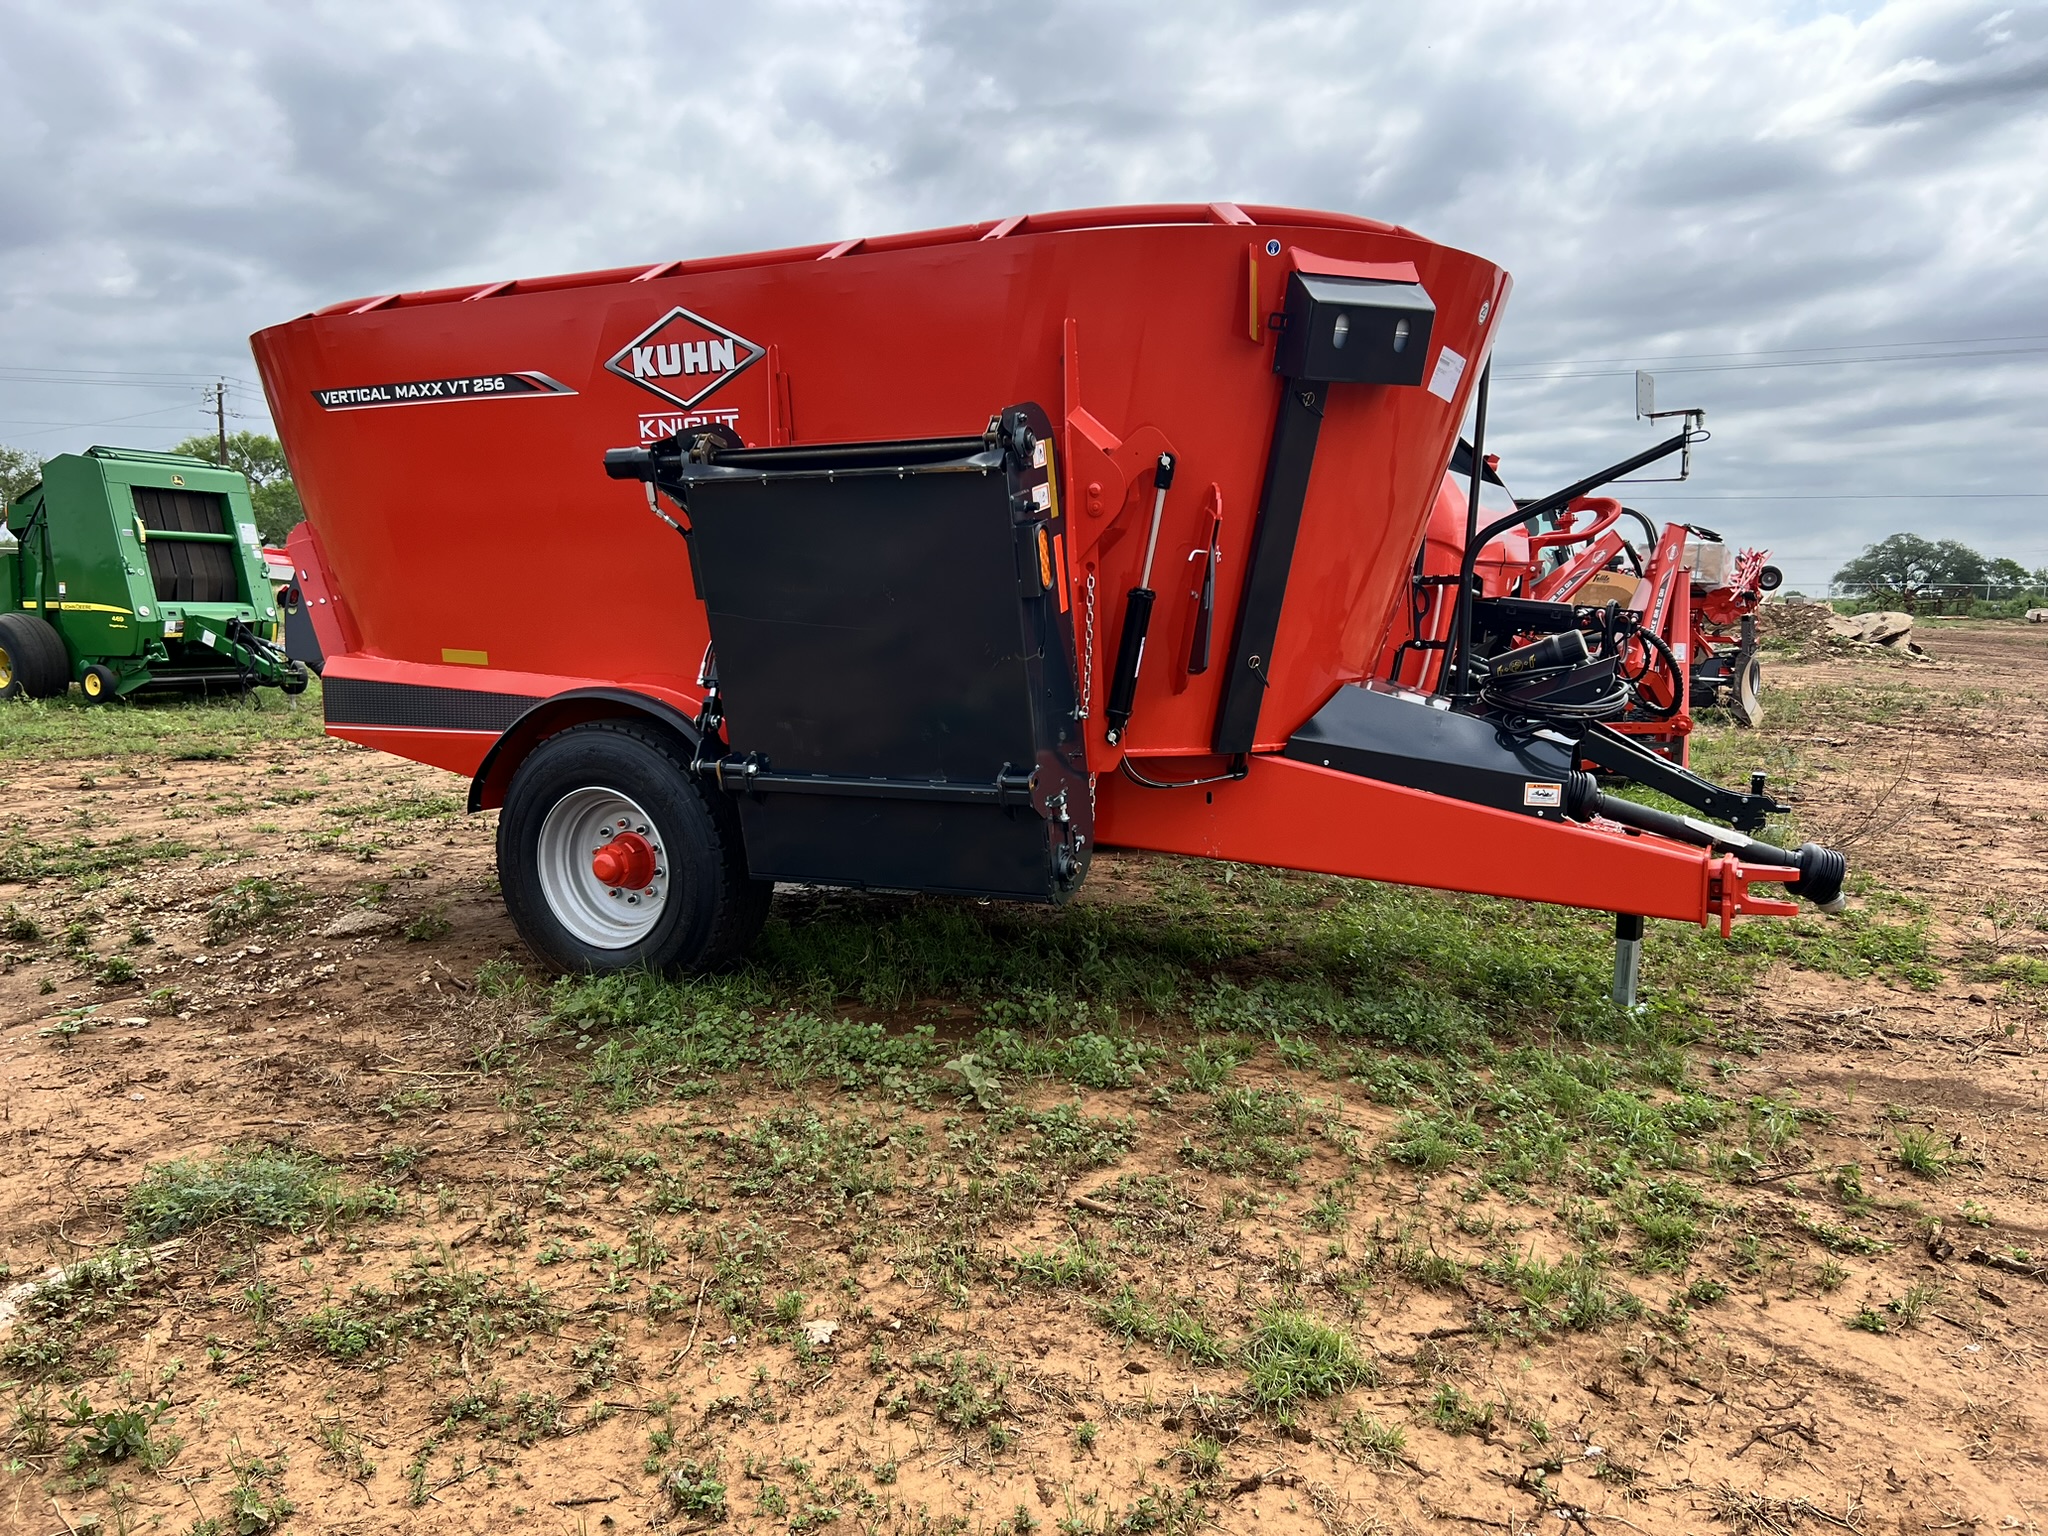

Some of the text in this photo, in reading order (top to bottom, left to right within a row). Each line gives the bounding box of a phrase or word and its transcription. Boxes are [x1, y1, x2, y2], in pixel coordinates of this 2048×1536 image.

[632, 338, 736, 379] KUHN
[320, 377, 505, 405] VERTICAL MAXX VT 256
